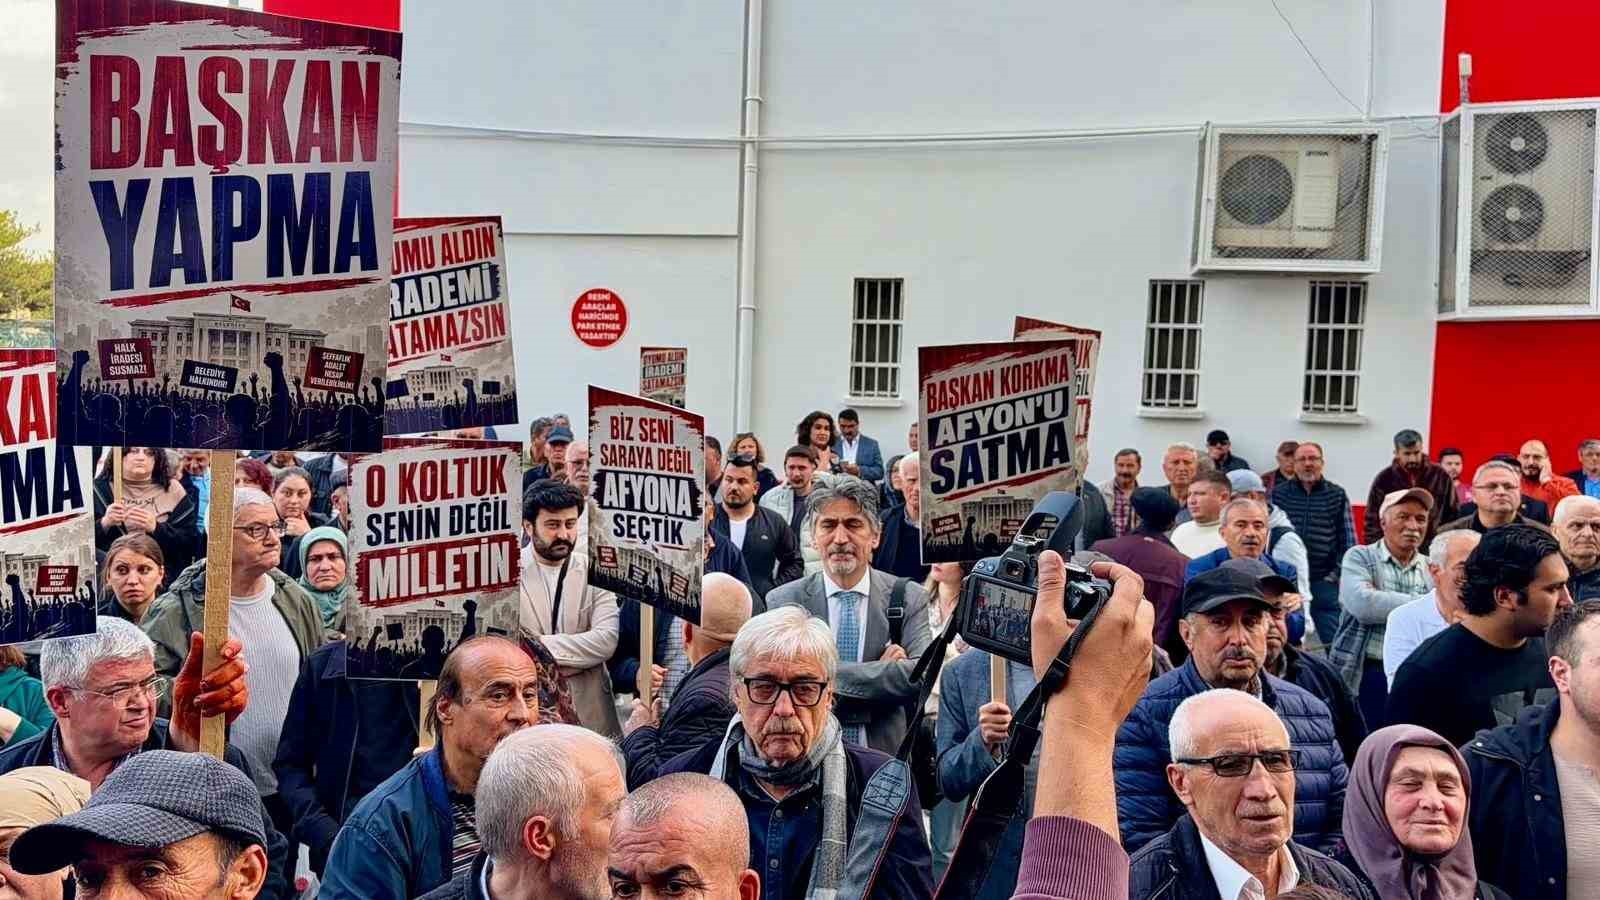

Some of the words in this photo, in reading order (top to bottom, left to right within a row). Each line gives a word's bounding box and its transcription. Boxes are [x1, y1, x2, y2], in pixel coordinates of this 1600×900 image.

[90, 55, 380, 174] BAŞKAN
[88, 171, 379, 290] YAPMA
[441, 226, 496, 267] ALDIN
[109, 364, 147, 376] SUSMAZ!
[114, 342, 136, 353] HALK
[926, 368, 994, 414] BAŞKAN
[1000, 353, 1069, 397] KORKMA
[610, 412, 634, 441] BİZ
[639, 416, 675, 445] SENİ
[936, 389, 1063, 447] AFYON'U
[366, 464, 386, 508] O
[399, 454, 508, 505] KOLTUK
[600, 444, 653, 471] SARAYA
[658, 446, 694, 475] DEĞİL
[930, 420, 1070, 496] SATMA
[603, 472, 693, 517] AFYONA
[366, 505, 441, 547] SENİN
[449, 496, 512, 537] DEĞİL
[613, 513, 684, 545] SEÇTİK
[368, 538, 510, 601] MİLLETİN
